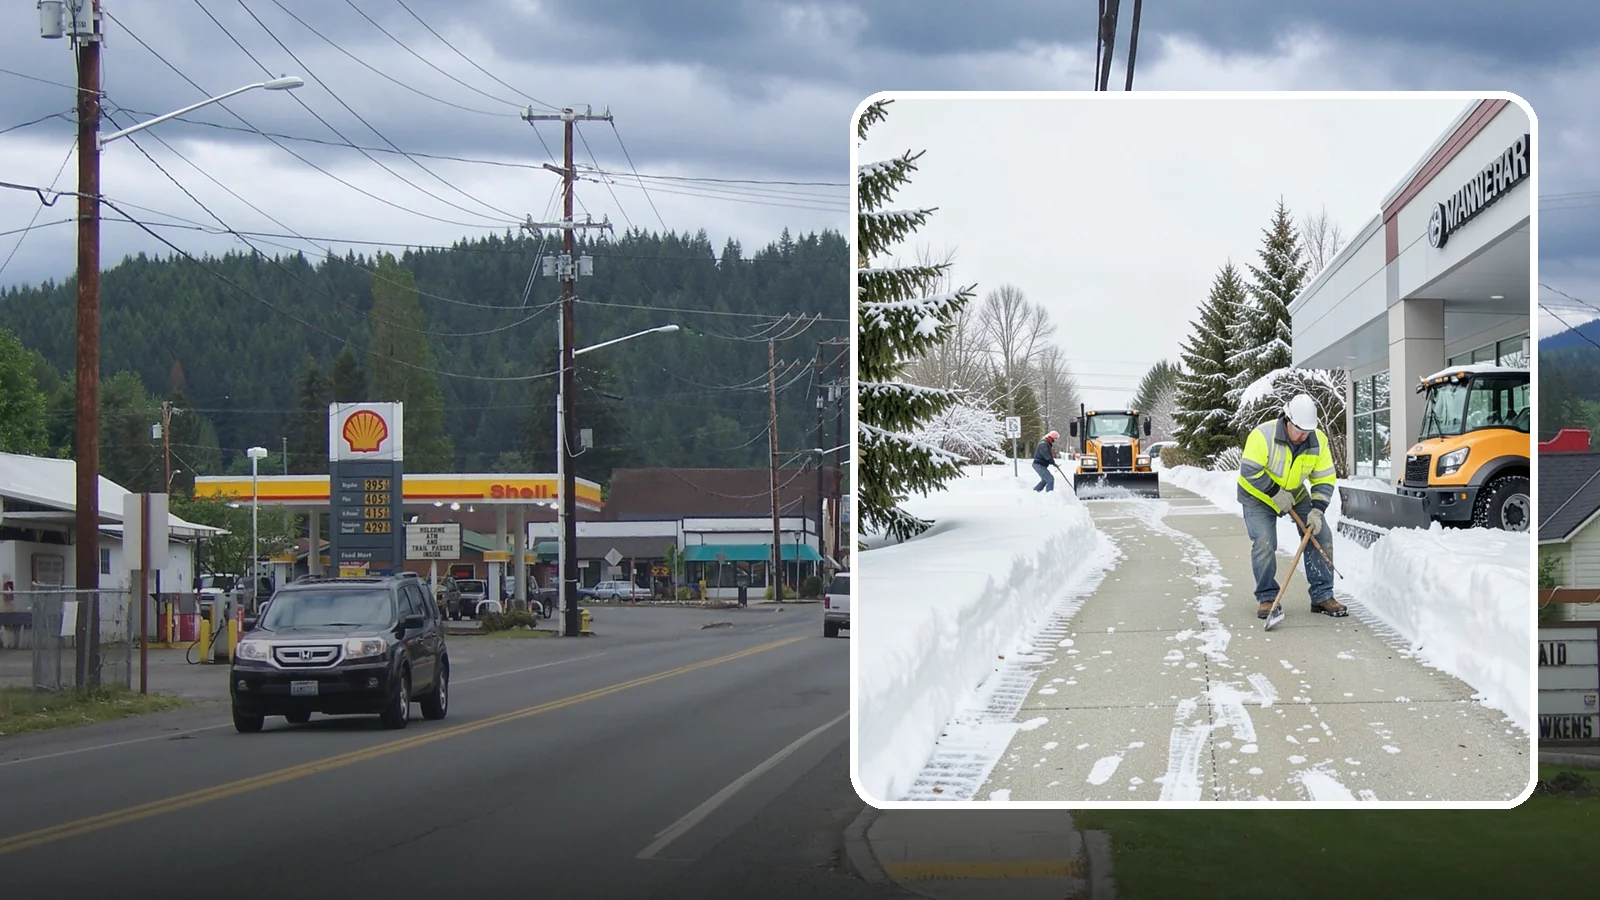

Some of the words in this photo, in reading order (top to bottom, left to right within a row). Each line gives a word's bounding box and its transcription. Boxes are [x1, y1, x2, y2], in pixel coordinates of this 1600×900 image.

[366, 480, 384, 490] 395
[490, 484, 547, 499] Shell
[366, 494, 384, 504] 405
[366, 508, 383, 518] 415
[366, 522, 384, 533] 429
[1539, 643, 1566, 665] AID
